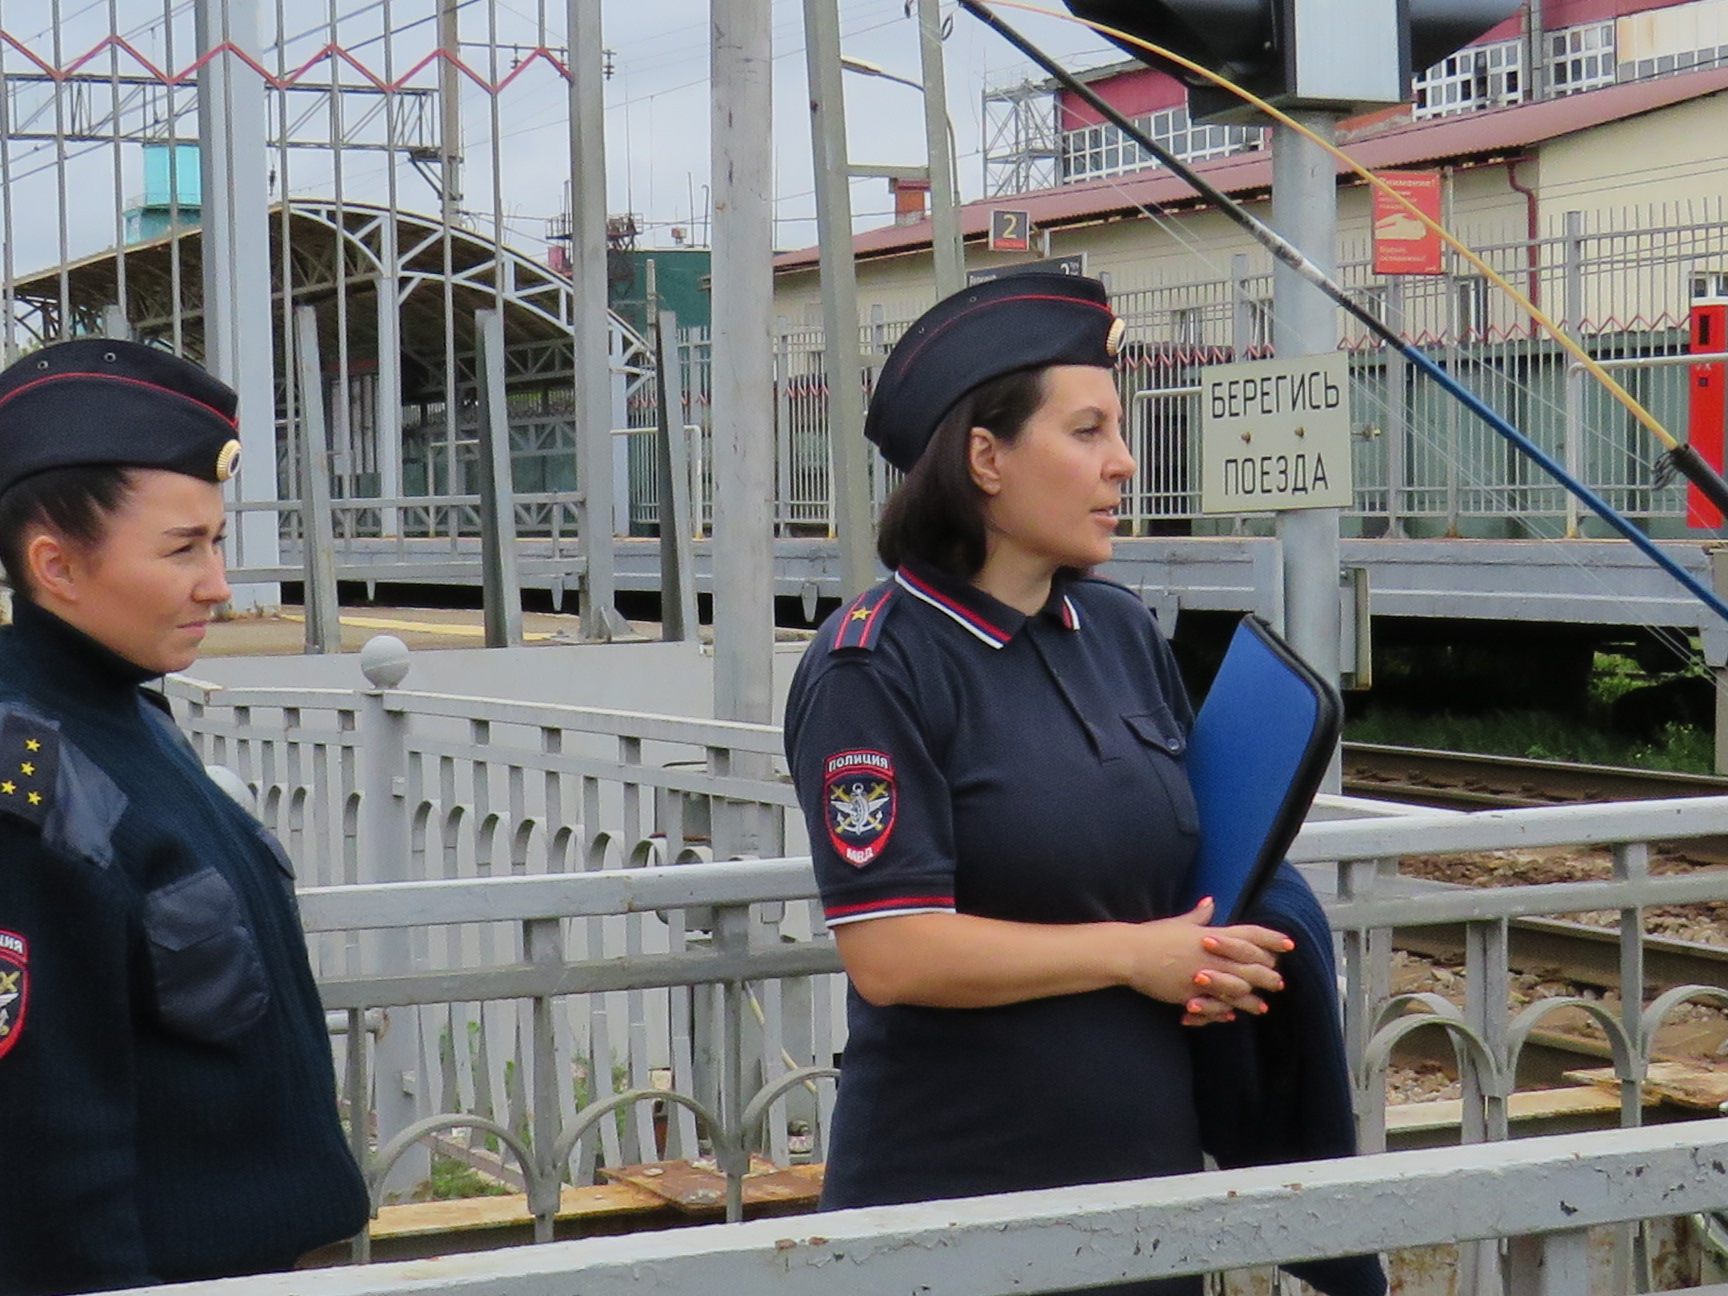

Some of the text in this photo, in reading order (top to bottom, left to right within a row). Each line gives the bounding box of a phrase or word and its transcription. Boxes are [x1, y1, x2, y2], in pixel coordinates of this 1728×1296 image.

[1002, 214, 1019, 239] 2
[1211, 371, 1340, 419] БЕРЕГИСЬ
[1224, 452, 1329, 495] ПОЕЗДА
[828, 754, 889, 772] ПОЛИЦИЯ
[845, 847, 874, 863] МВД
